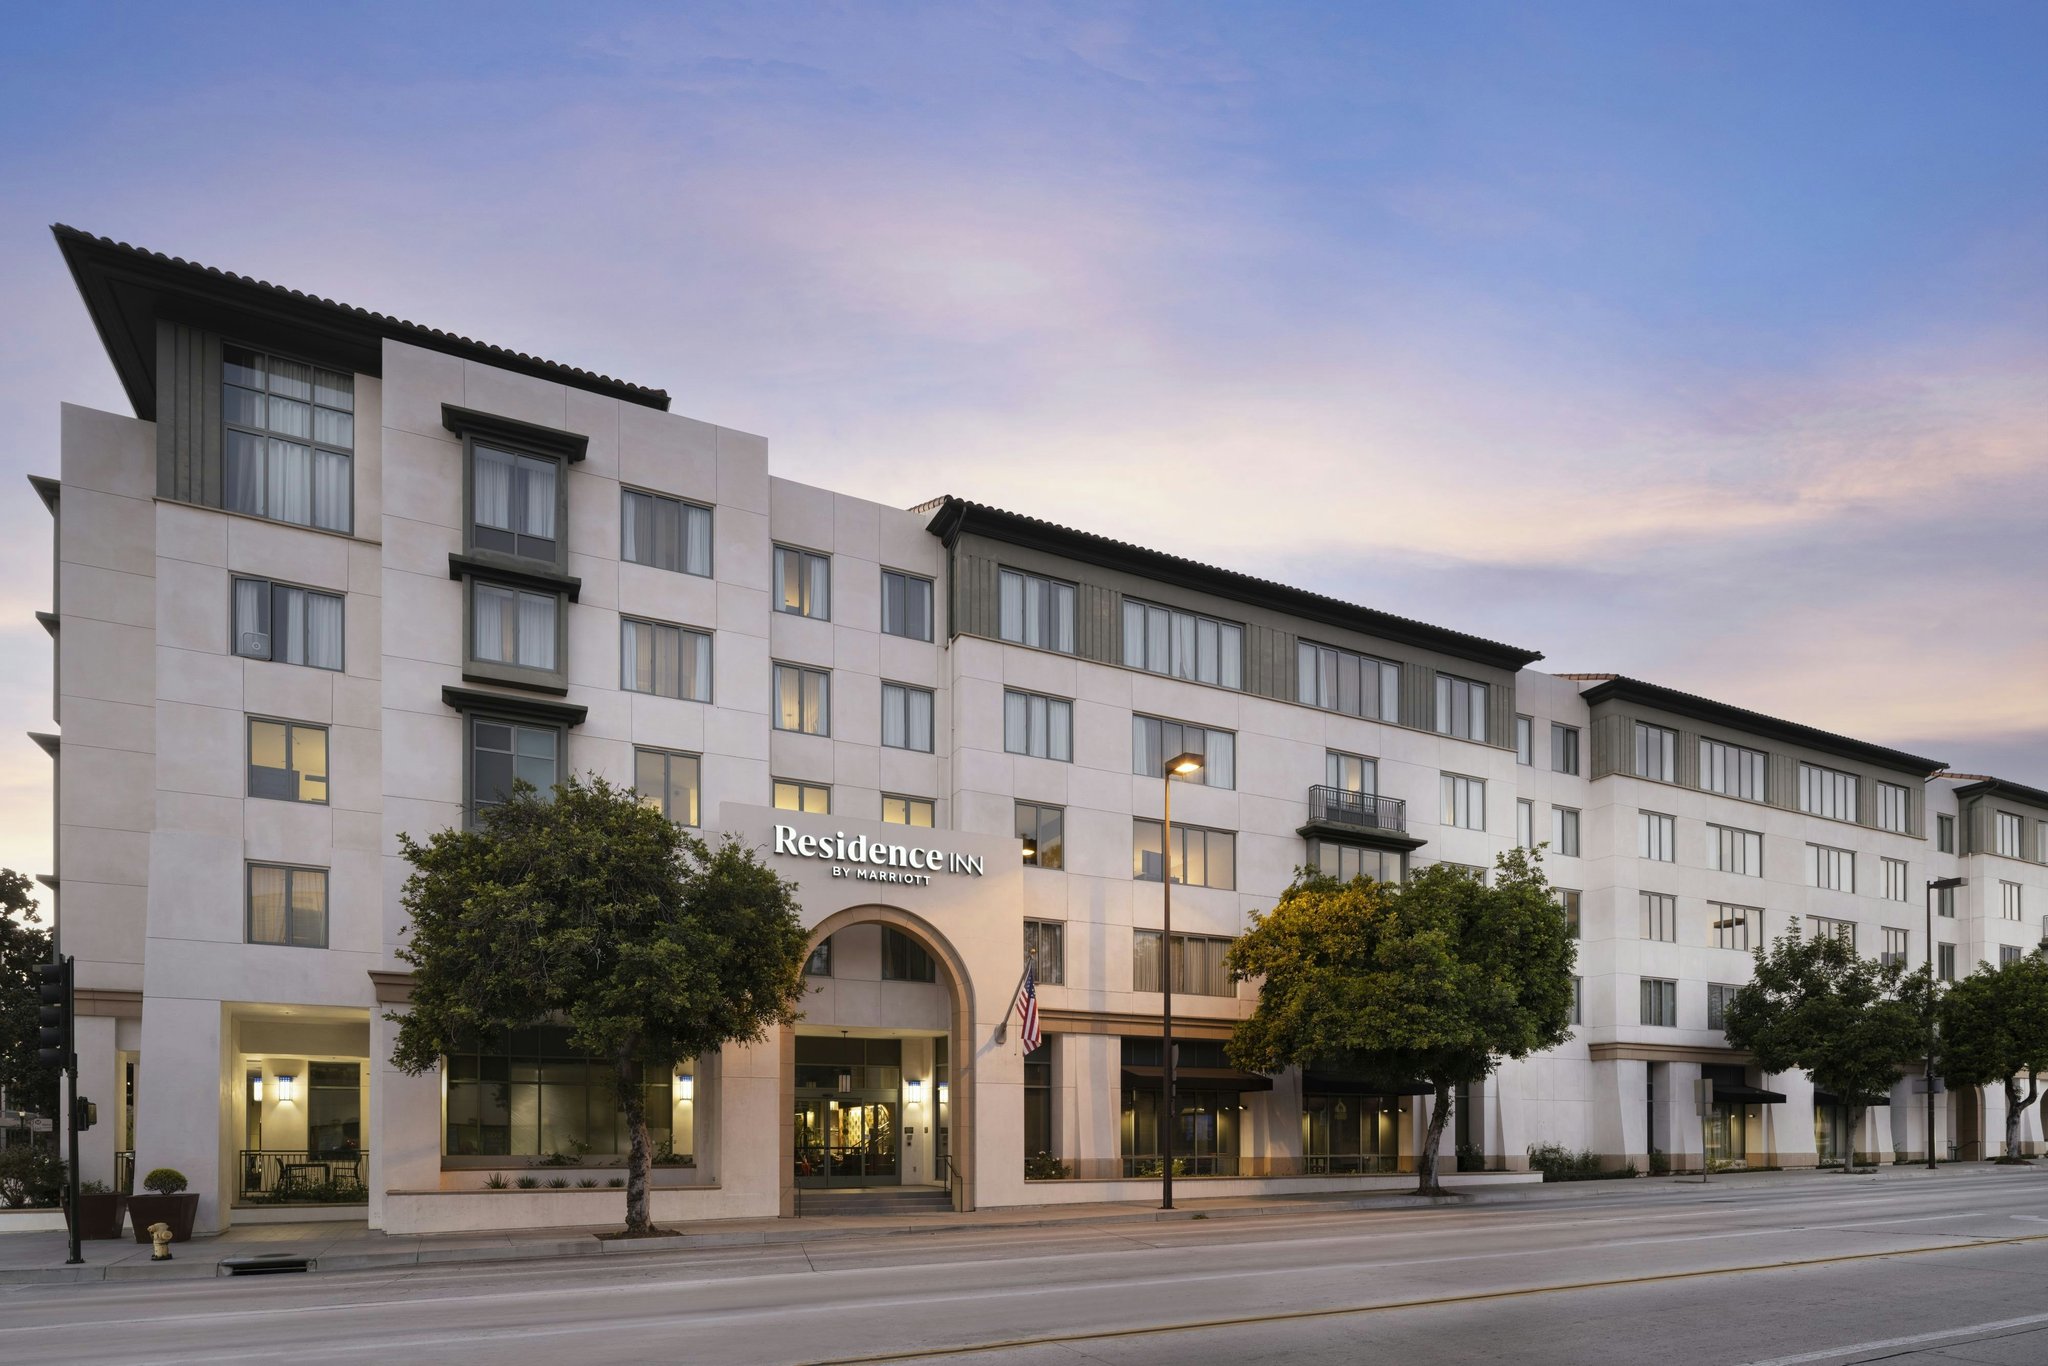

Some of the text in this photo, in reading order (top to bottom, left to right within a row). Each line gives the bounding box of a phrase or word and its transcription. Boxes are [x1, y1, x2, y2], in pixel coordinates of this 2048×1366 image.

[774, 824, 984, 876] Residence INN
[832, 866, 931, 886] BY MARRIOTT
